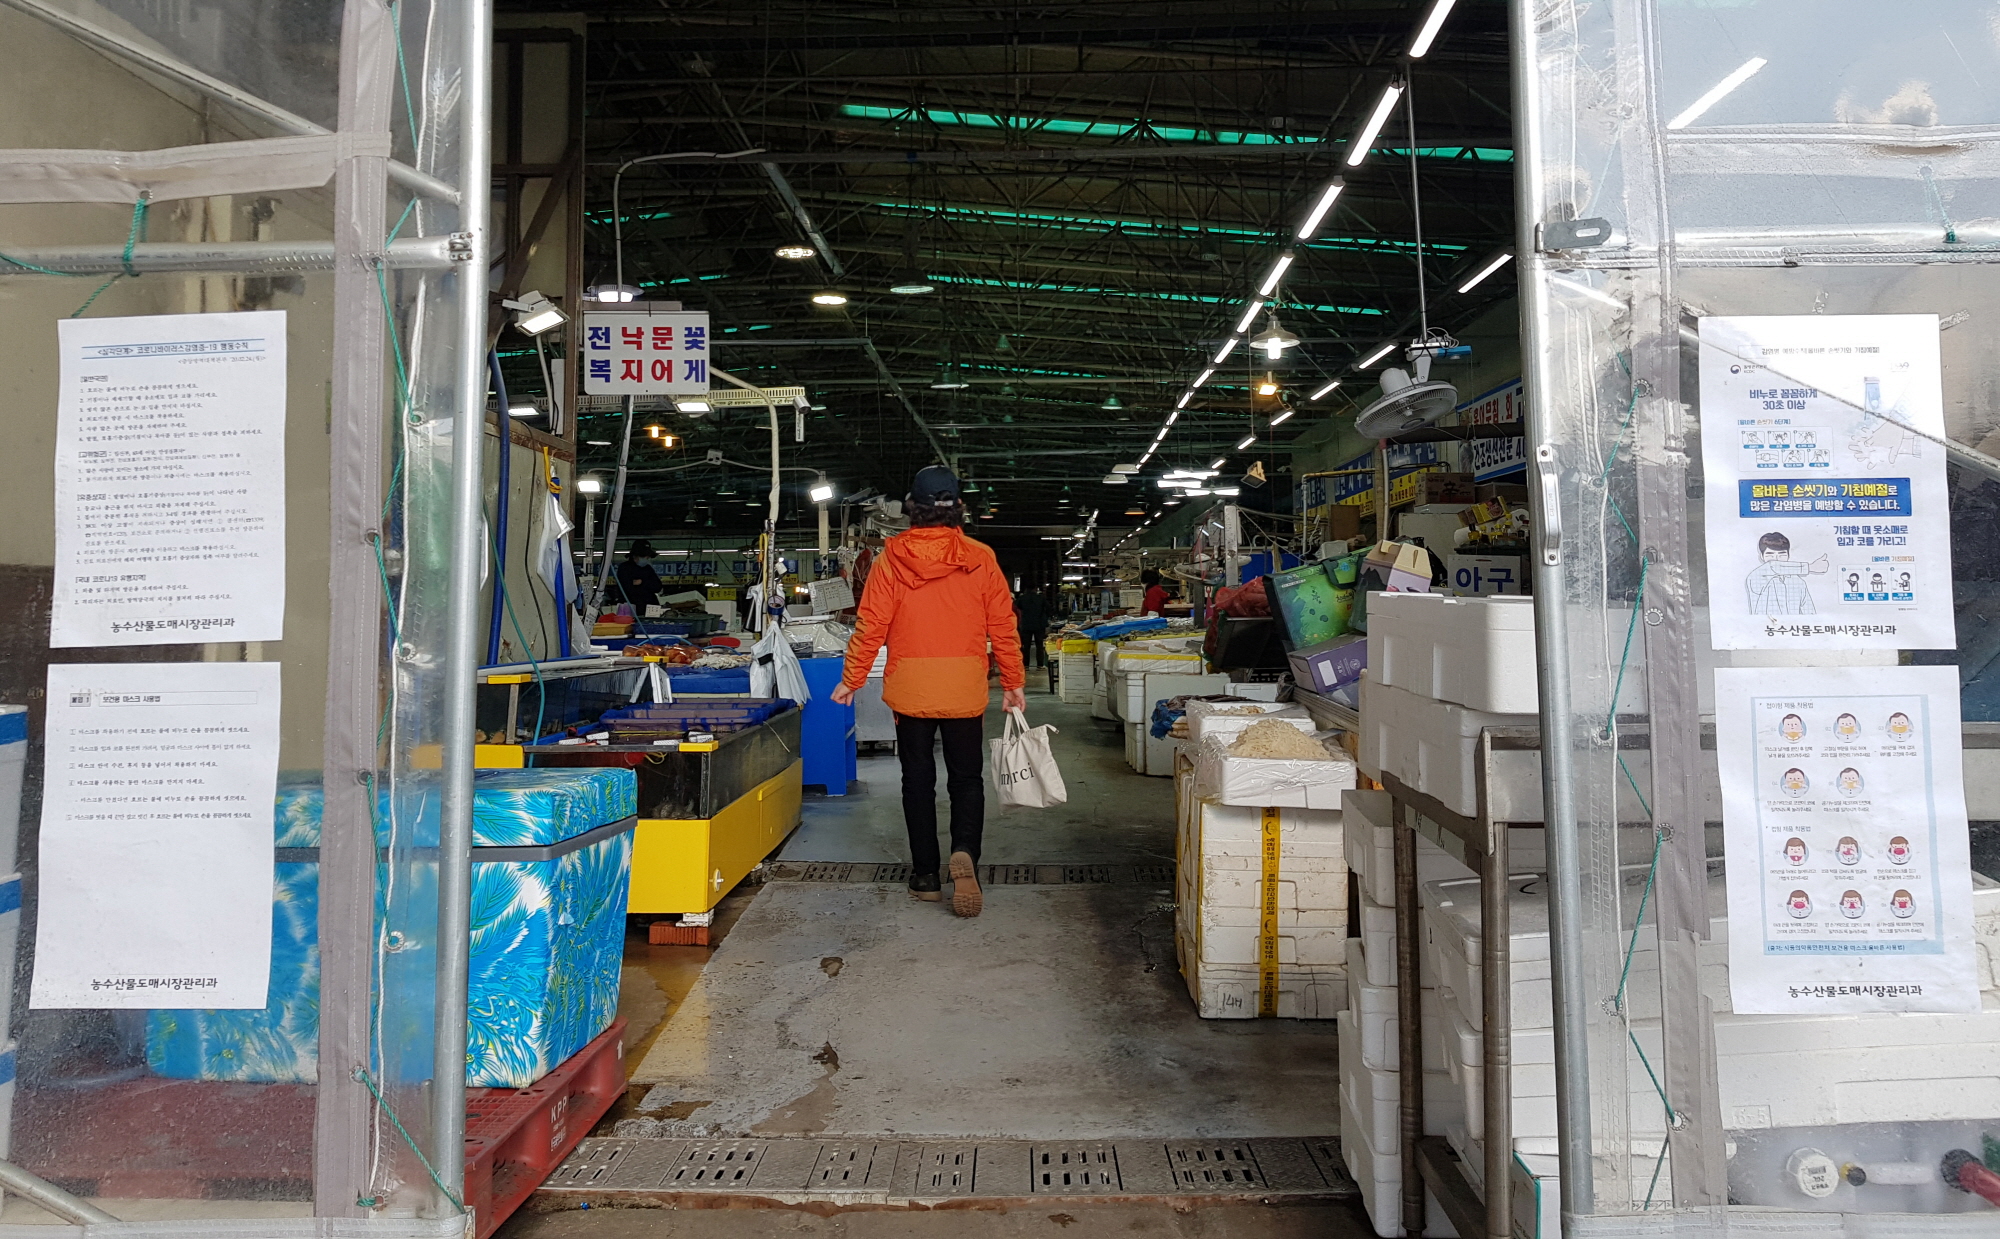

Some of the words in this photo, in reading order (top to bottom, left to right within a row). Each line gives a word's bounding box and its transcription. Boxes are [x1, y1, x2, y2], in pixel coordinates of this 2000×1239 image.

[588, 326, 611, 383] 전복
[620, 326, 644, 383] 낙지
[651, 326, 674, 383] 문어
[683, 326, 706, 383] 꽃게
[1749, 389, 1778, 399] 비누로
[1780, 388, 1820, 398] 꼼꼼하게
[1762, 400, 1784, 409] 30초
[1786, 399, 1806, 409] 이상
[1752, 484, 1788, 497] 올바른
[1792, 484, 1837, 496] 손씻기와
[1840, 483, 1897, 496] 기침예절로
[1750, 500, 1770, 511] 많은
[1773, 500, 1812, 510] 감염병을
[1814, 499, 1844, 510] 예방할
[1846, 499, 1856, 510] 수
[1858, 499, 1900, 509] 있습니다.
[1833, 525, 1860, 535] 기침할
[1861, 525, 1871, 534] 때
[1873, 525, 1908, 534] 옷소매로
[1836, 536, 1854, 546] 입과
[1856, 536, 1874, 546] 코를
[1876, 536, 1906, 545] 가리고!
[1455, 566, 1514, 593] 아구
[110, 617, 235, 632] 농수산물도매시장관리과
[1765, 625, 1896, 636] 농수산물도매시장관리과
[1000, 761, 1035, 785] mrci
[90, 978, 217, 990] 농수산물도매시장관리과
[1787, 985, 1922, 997] 농수산물도매시장관리과
[550, 1095, 568, 1124] KPP
